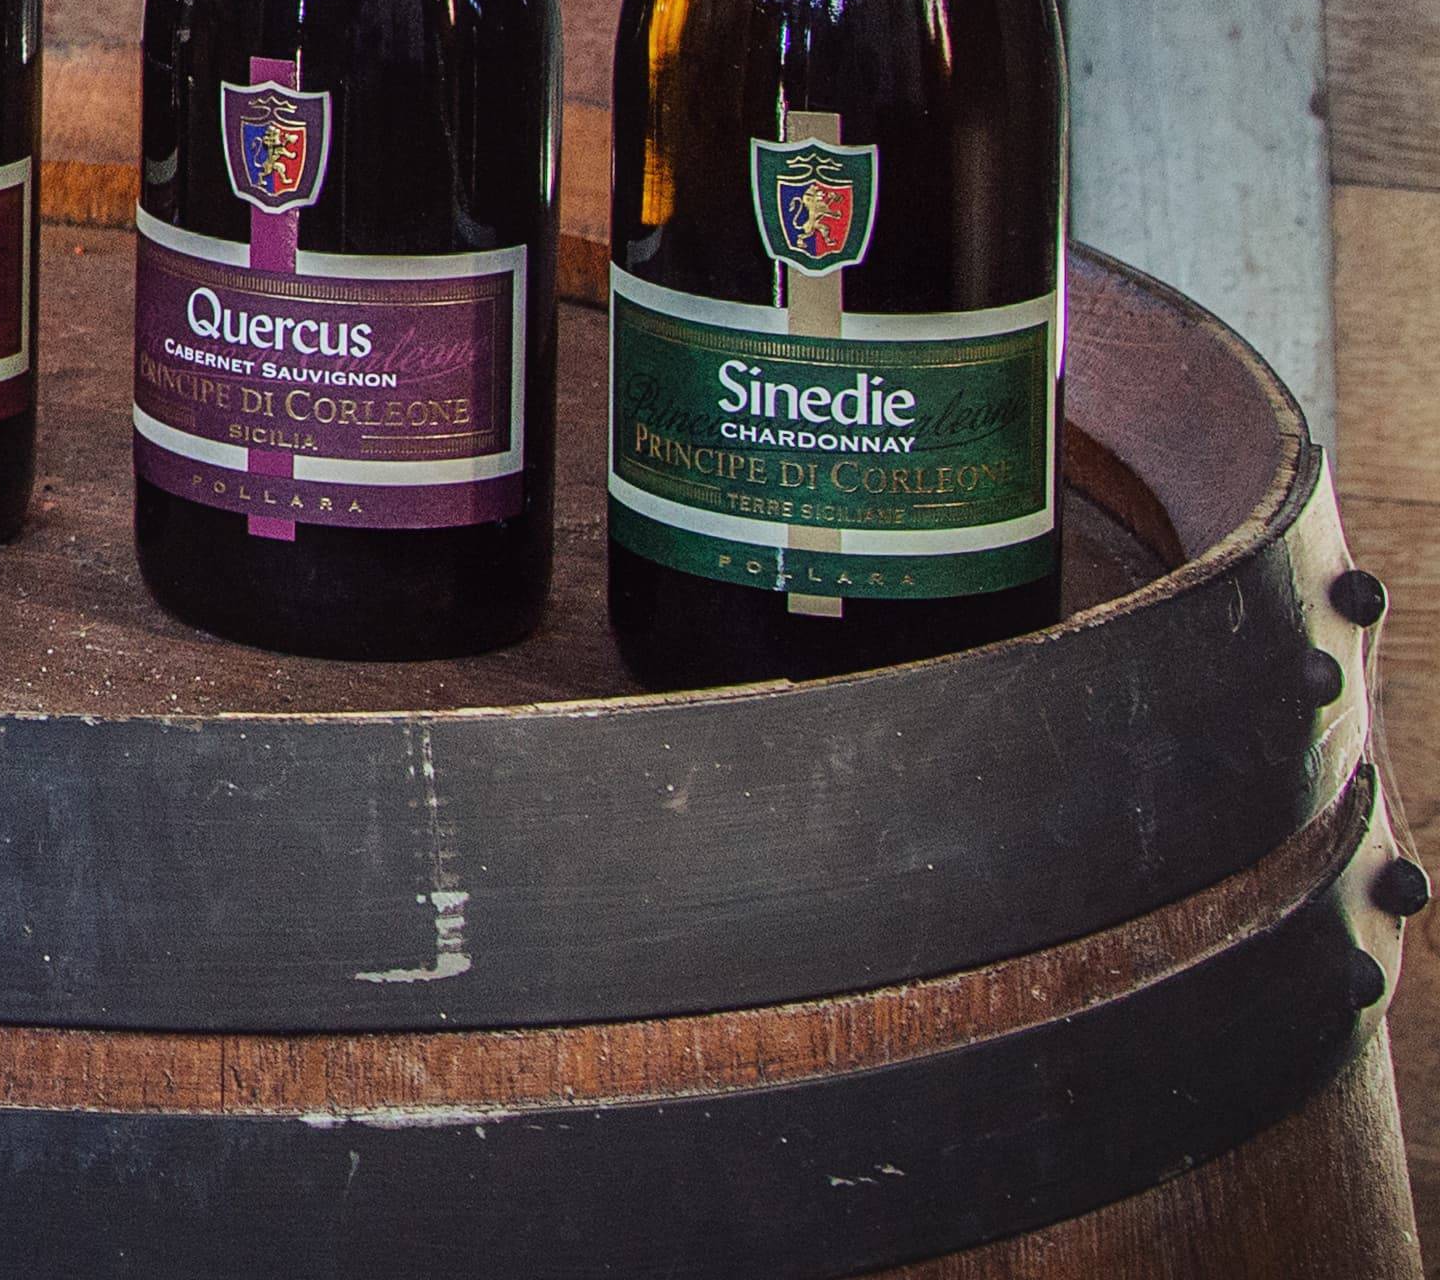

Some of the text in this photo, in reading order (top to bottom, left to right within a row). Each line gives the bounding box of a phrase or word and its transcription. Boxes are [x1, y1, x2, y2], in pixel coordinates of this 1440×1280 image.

[187, 287, 374, 358] Quercus
[164, 337, 398, 388] CABERNET SAUVIGNON
[241, 386, 275, 418] DI
[285, 389, 472, 427] CORLEONE
[717, 358, 917, 428] Sinedie
[228, 422, 319, 451] SICILIA
[634, 421, 768, 486] PRINCIPE
[779, 461, 819, 490] DI
[720, 421, 917, 453] CHARDONNAY
[191, 473, 364, 514] POLLARA
[726, 491, 906, 525] TERRE SICILIANE
